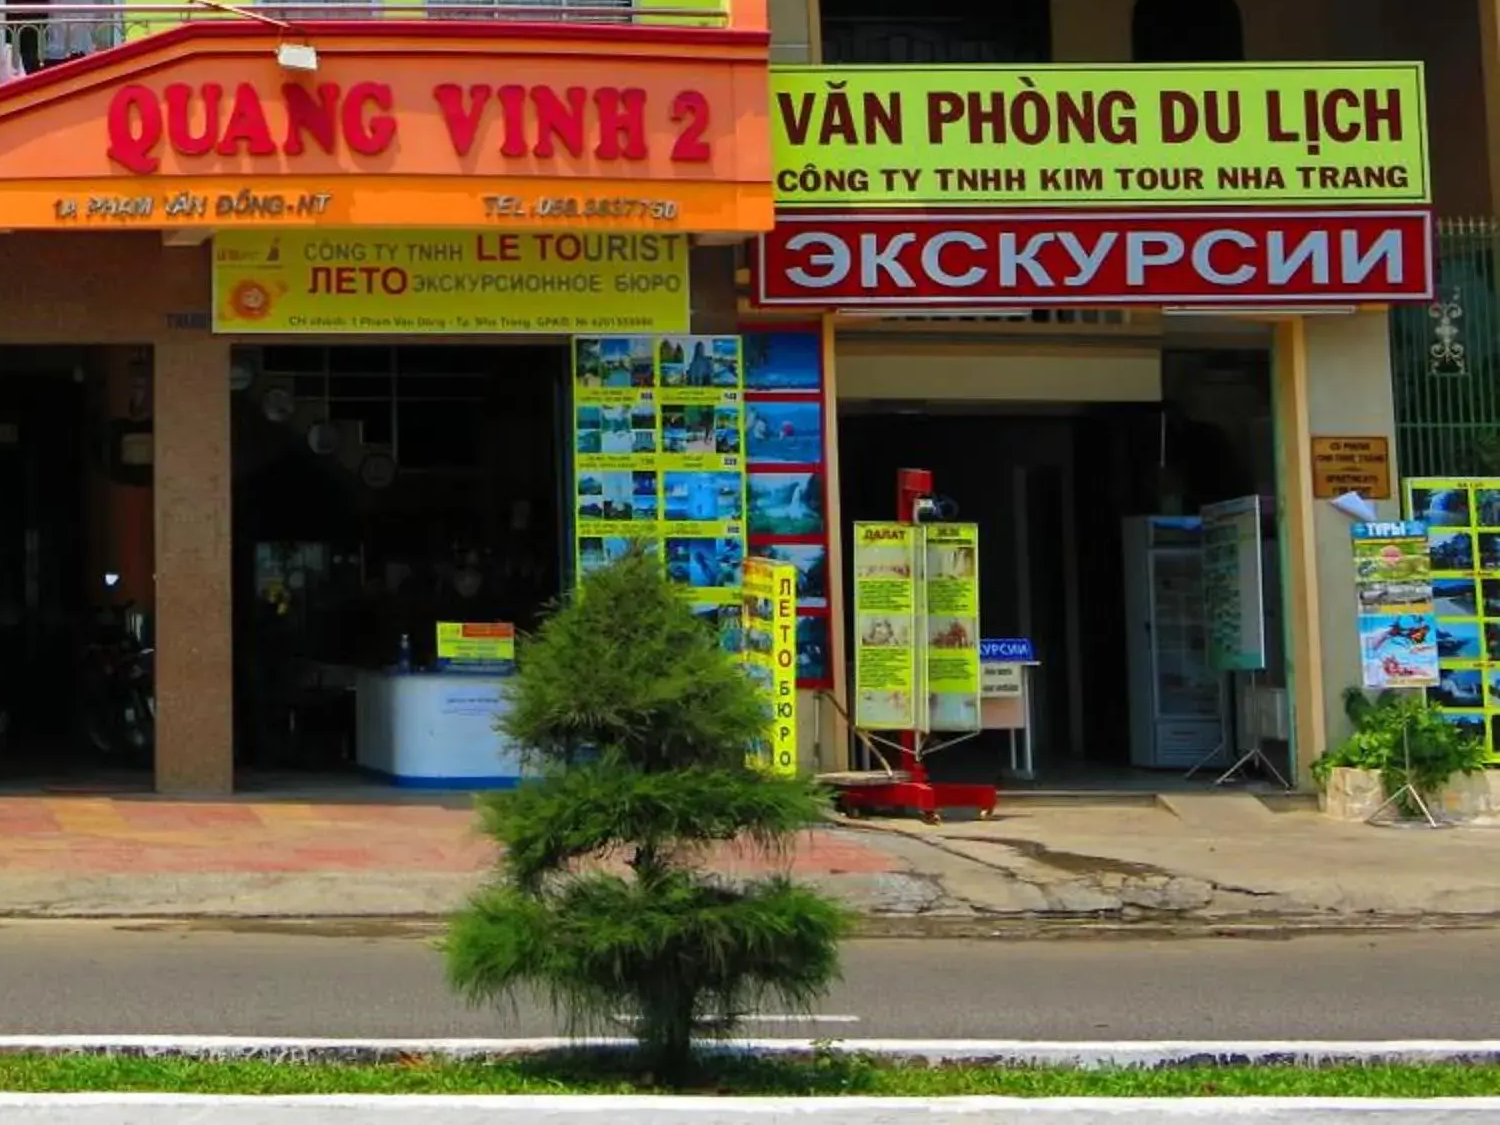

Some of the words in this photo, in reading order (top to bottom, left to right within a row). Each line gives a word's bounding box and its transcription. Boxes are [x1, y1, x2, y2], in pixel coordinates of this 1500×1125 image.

[107, 81, 398, 174] QUANG
[434, 84, 647, 161] VINH
[669, 90, 711, 162] 2
[776, 80, 903, 146] VĂN
[927, 76, 1138, 144] PHÒNG
[1159, 90, 1242, 144] DU
[1265, 88, 1403, 155] LỊCH
[777, 163, 869, 192] CÔNG
[879, 169, 922, 191] TY
[934, 168, 1025, 191] TNHH
[1040, 168, 1103, 191] KIM
[1114, 168, 1204, 190] TOUR
[1217, 166, 1286, 189] NHA
[1295, 165, 1408, 189] TRANG
[304, 238, 367, 262] CÔNG
[374, 243, 398, 262] TY
[407, 243, 463, 262] TNHH
[476, 233, 520, 262] LE
[534, 233, 681, 263] TOURIST
[785, 229, 1404, 288] ЭКСКУРСИИ
[308, 266, 408, 295] ЛЕТО
[413, 273, 602, 295] ЭКСКУРСИОННОЕ
[614, 273, 682, 294] БЮРО
[779, 578, 792, 668] ЛЕТО
[979, 642, 1028, 656] УРСИИ
[777, 680, 793, 767] БЮРО
